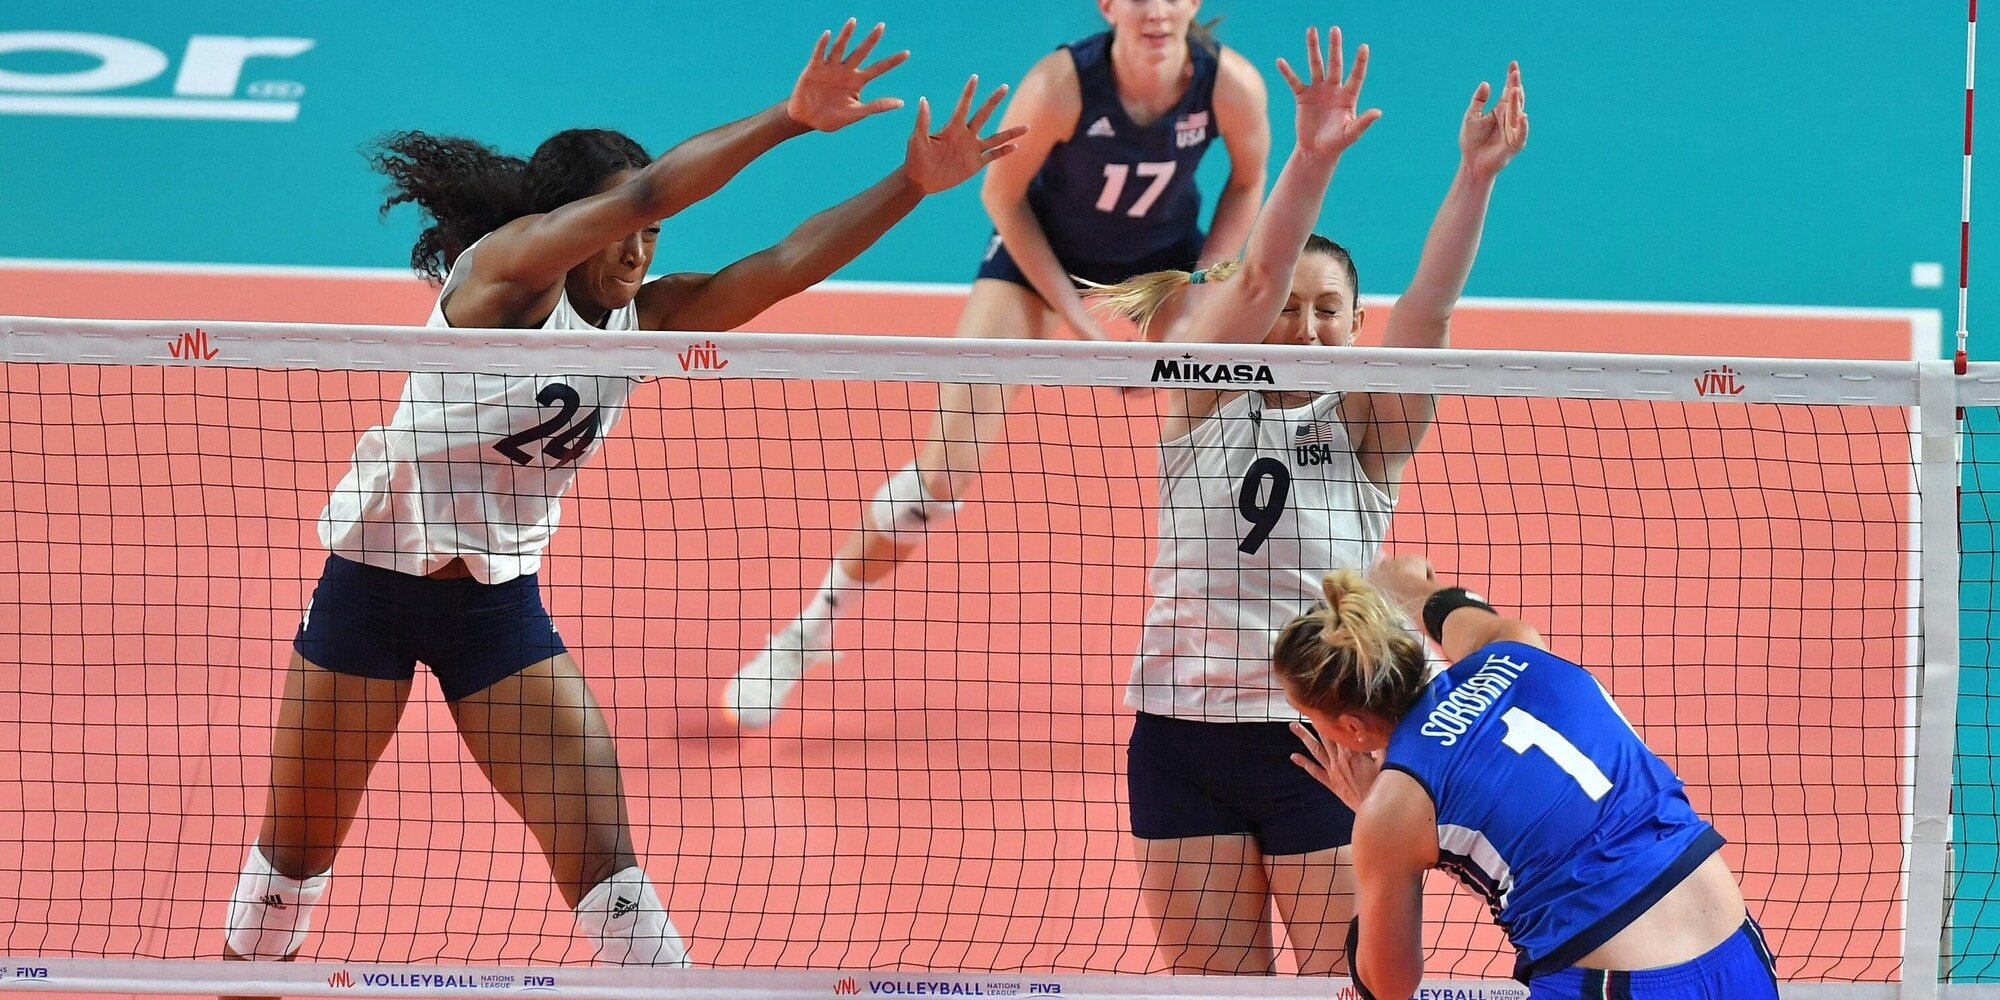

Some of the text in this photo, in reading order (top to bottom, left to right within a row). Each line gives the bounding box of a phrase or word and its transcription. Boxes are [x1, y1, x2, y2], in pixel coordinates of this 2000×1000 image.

[1095, 160, 1177, 217] 17
[168, 328, 219, 360] VNL
[677, 340, 729, 371] VNL
[1151, 353, 1275, 384] MIKASA
[1694, 365, 1745, 396] VNL
[492, 383, 600, 471] 24
[1296, 444, 1333, 466] USA
[1237, 457, 1291, 555] 9
[1500, 706, 1614, 802] 1
[327, 970, 477, 988] VNL VOLLEYBALL
[833, 976, 983, 996] VNL VOLLEYBALL
